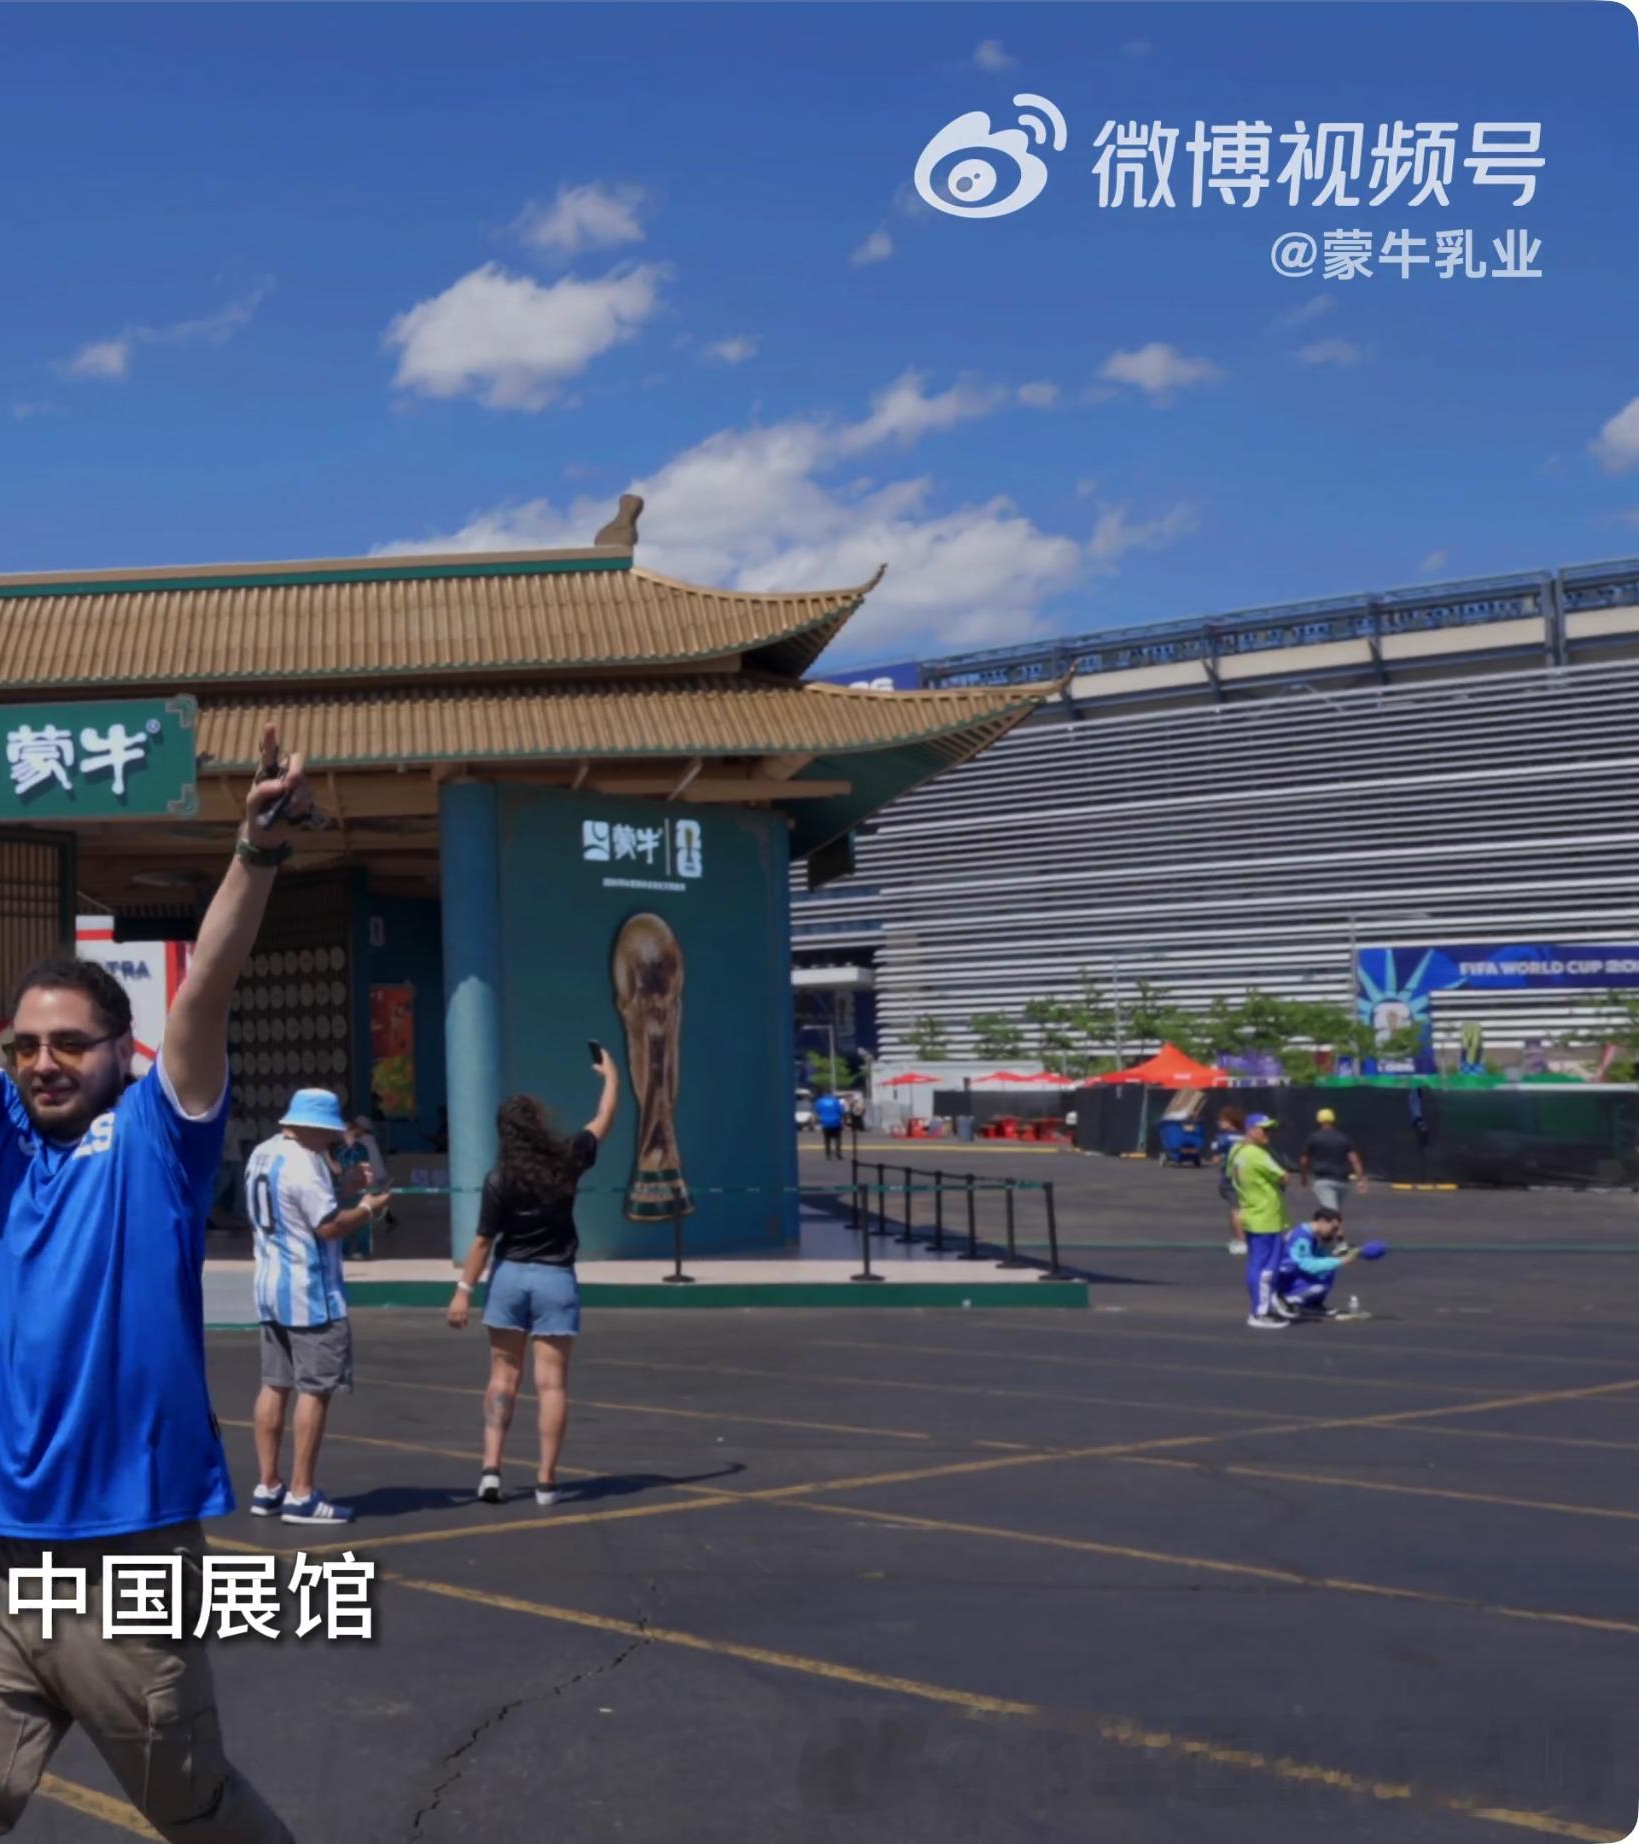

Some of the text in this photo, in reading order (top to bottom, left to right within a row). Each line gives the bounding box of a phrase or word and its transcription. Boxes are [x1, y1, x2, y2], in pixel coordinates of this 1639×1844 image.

[6, 724, 148, 795] 蒙牛
[613, 823, 663, 864] 蒙牛
[1459, 961, 1498, 975] FIFA
[1498, 960, 1564, 975] WORLD
[1566, 959, 1603, 974] CUP
